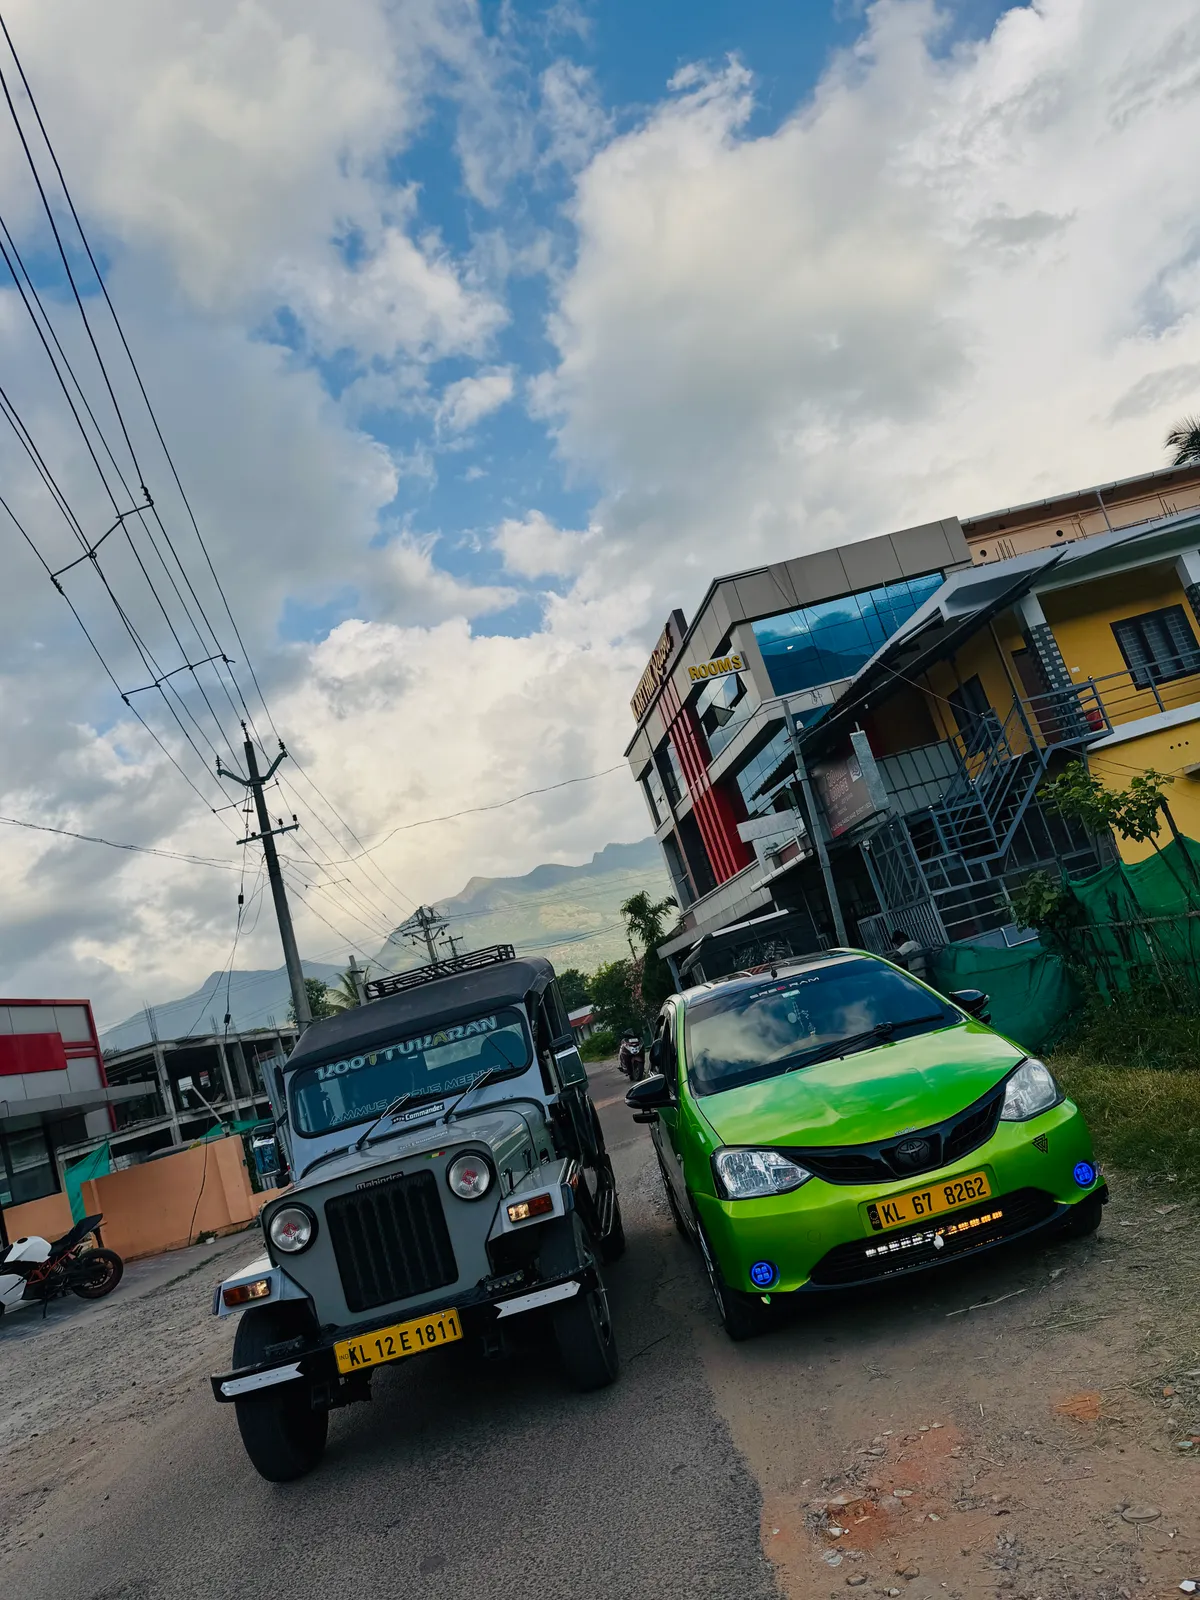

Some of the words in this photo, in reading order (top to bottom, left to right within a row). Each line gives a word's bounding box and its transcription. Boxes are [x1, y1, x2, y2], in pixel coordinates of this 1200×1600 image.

[688, 655, 742, 681] ROOMS
[404, 1104, 444, 1121] Commander
[881, 1202, 906, 1224] KL
[912, 1192, 933, 1214] 67
[943, 1177, 987, 1205] 8262
[348, 1344, 372, 1366] KL
[375, 1336, 397, 1357] 12
[399, 1331, 412, 1351] E
[415, 1317, 458, 1345] 1811
